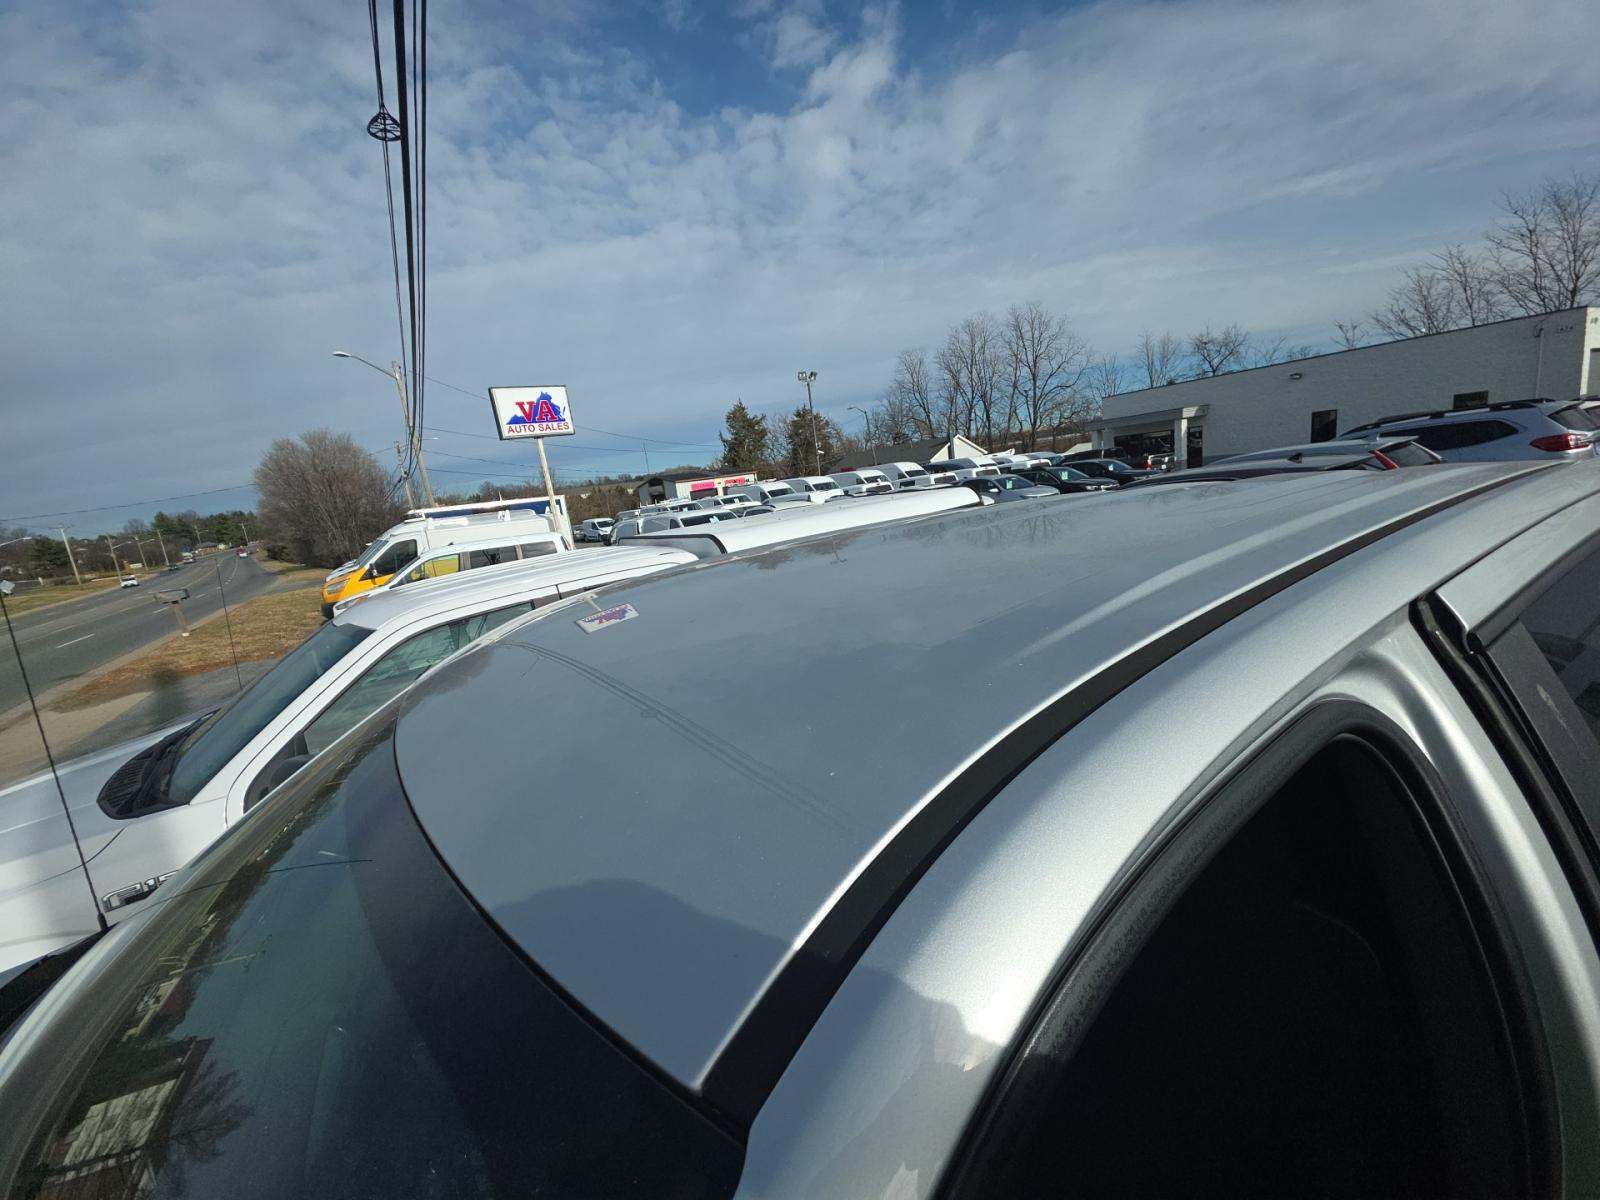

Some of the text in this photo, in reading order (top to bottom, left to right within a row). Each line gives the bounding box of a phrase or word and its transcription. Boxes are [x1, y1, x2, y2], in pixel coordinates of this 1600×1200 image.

[515, 400, 558, 422] VA
[508, 421, 570, 434] AUTO SALES
